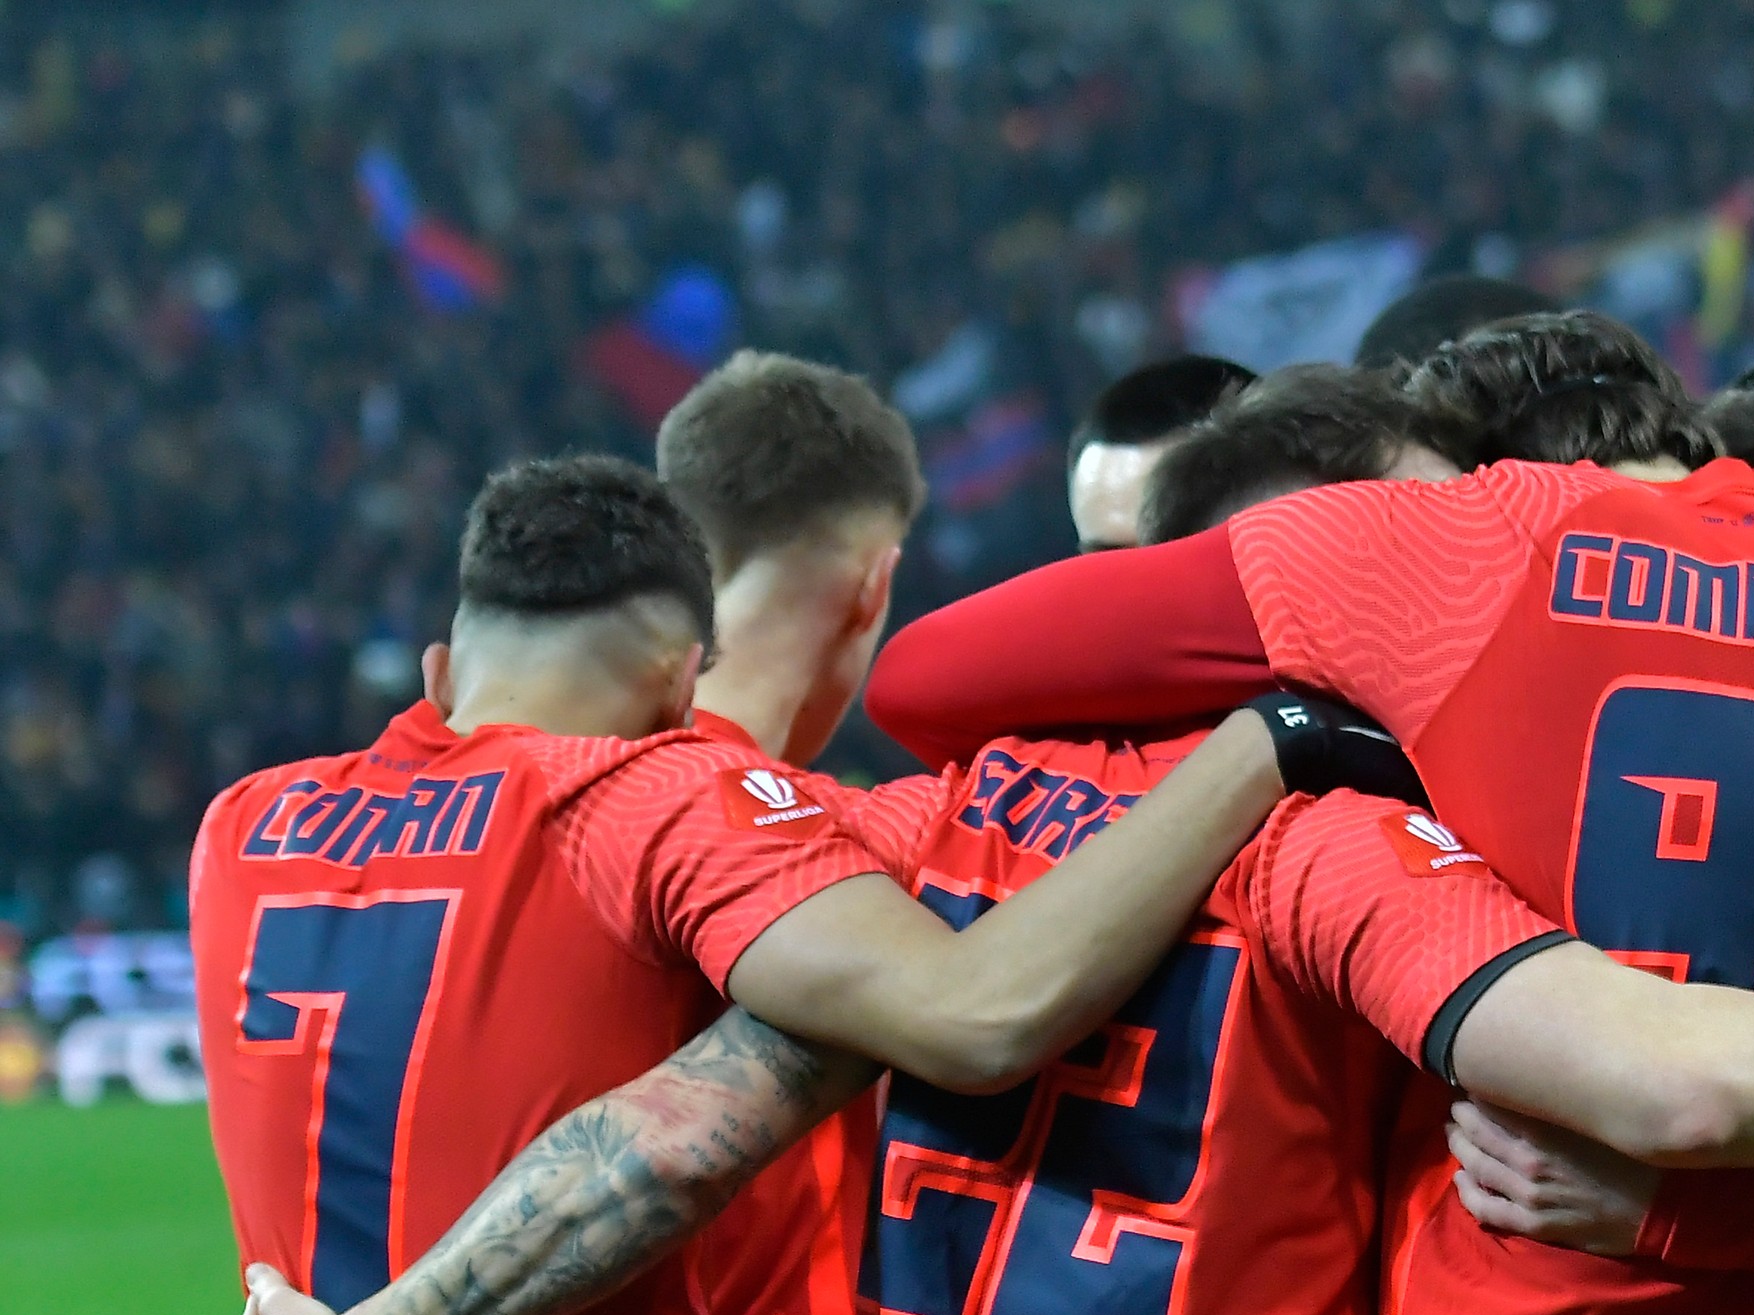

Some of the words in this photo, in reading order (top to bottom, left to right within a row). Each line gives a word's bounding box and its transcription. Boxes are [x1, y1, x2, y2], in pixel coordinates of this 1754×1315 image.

[238, 767, 508, 871] COMAN
[753, 805, 825, 827] SUPERLIGA
[236, 888, 462, 1315] 7
